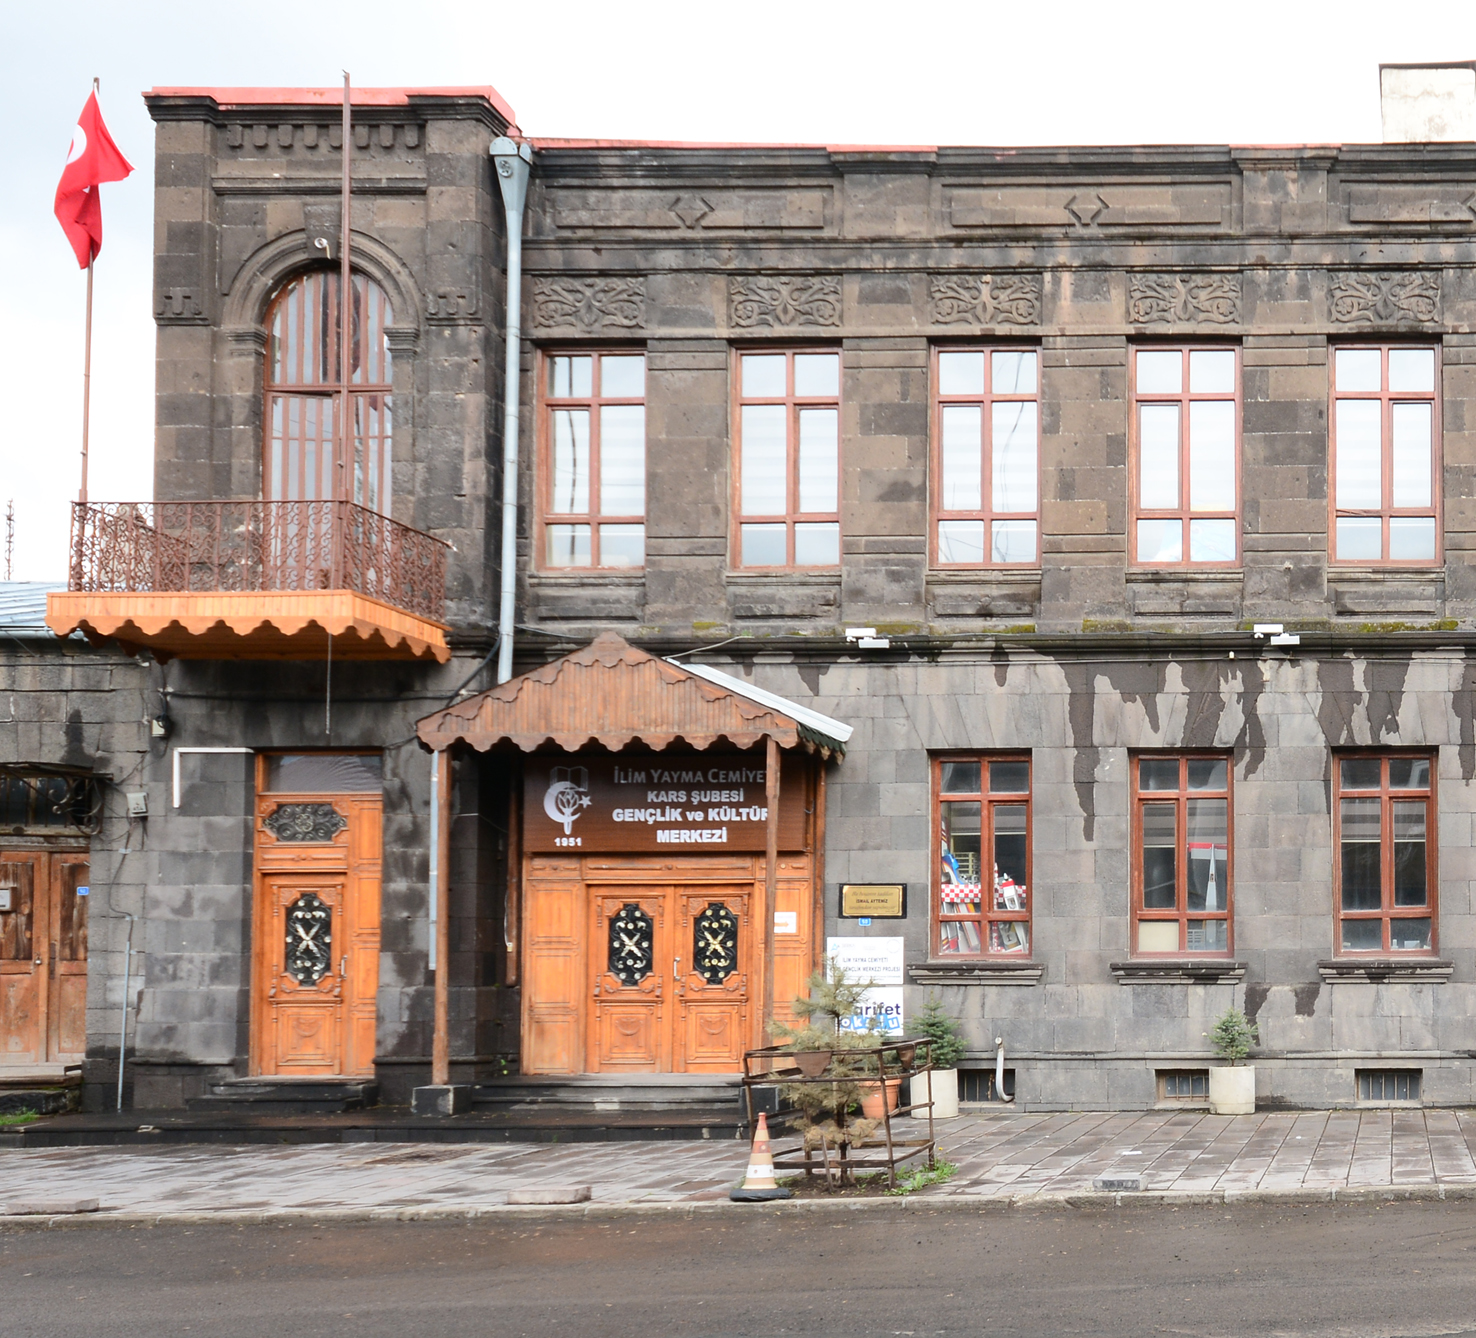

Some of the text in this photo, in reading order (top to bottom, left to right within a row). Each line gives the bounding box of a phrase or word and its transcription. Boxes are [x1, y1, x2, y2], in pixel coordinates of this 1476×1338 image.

[613, 766, 768, 784] İLİM YAYMA CEMİYE
[647, 788, 745, 805] KARS ŞUBESİ
[612, 805, 682, 824] GENÇLİK
[686, 810, 704, 822] ve
[554, 837, 582, 847] 1951
[656, 827, 728, 844] MERKEZİ
